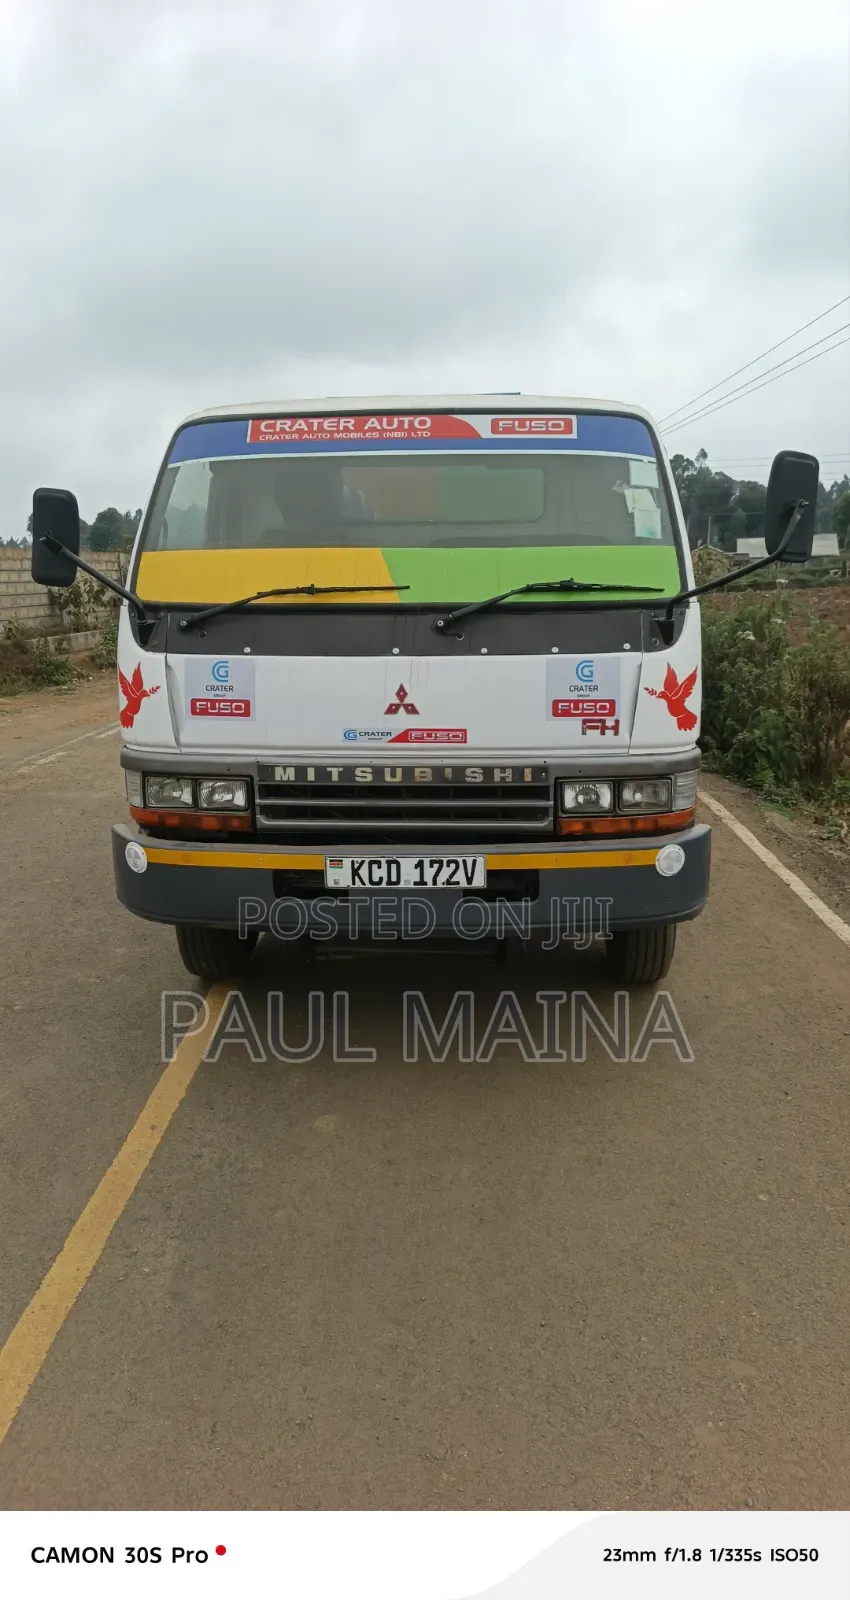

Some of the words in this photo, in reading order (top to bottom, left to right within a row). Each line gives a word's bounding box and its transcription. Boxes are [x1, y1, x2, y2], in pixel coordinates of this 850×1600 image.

[260, 418, 355, 433] CRATER
[363, 416, 432, 430] AUTO
[498, 420, 565, 431] FUSO
[259, 433, 299, 441] CRATER
[302, 432, 330, 440] AUTO
[333, 431, 380, 439] MOBILES
[205, 684, 234, 692] CRATER
[568, 684, 599, 692] CRATER
[196, 701, 245, 714] FUSO
[558, 702, 610, 714] FUSO
[581, 718, 620, 736] FH
[411, 732, 463, 740] FUSO
[274, 766, 533, 783] MITSUBISHI
[350, 859, 401, 886] KCD
[413, 859, 478, 886] 172V
